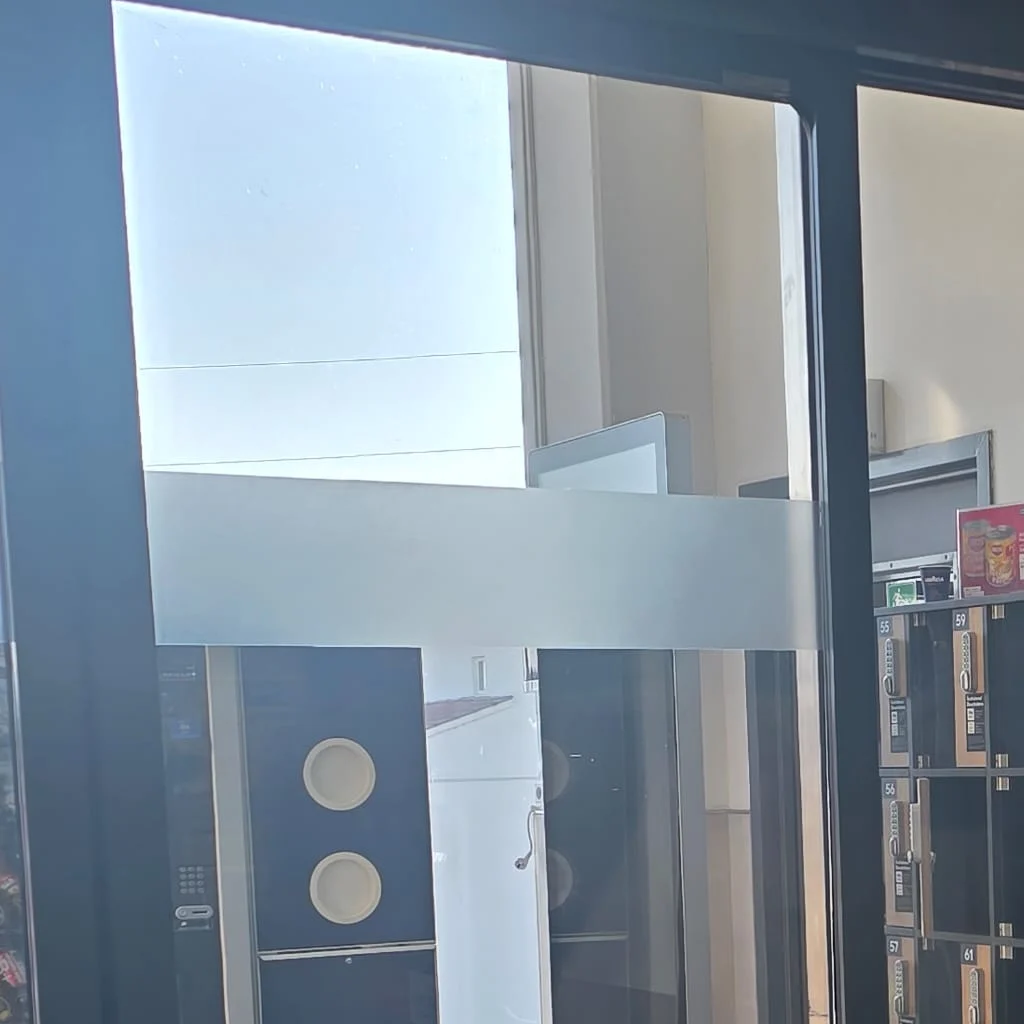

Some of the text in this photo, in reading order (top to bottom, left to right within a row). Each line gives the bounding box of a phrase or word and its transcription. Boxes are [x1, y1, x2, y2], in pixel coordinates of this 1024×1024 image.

[956, 613, 966, 626] 59
[889, 940, 899, 953] 57
[964, 949, 974, 961] 61
